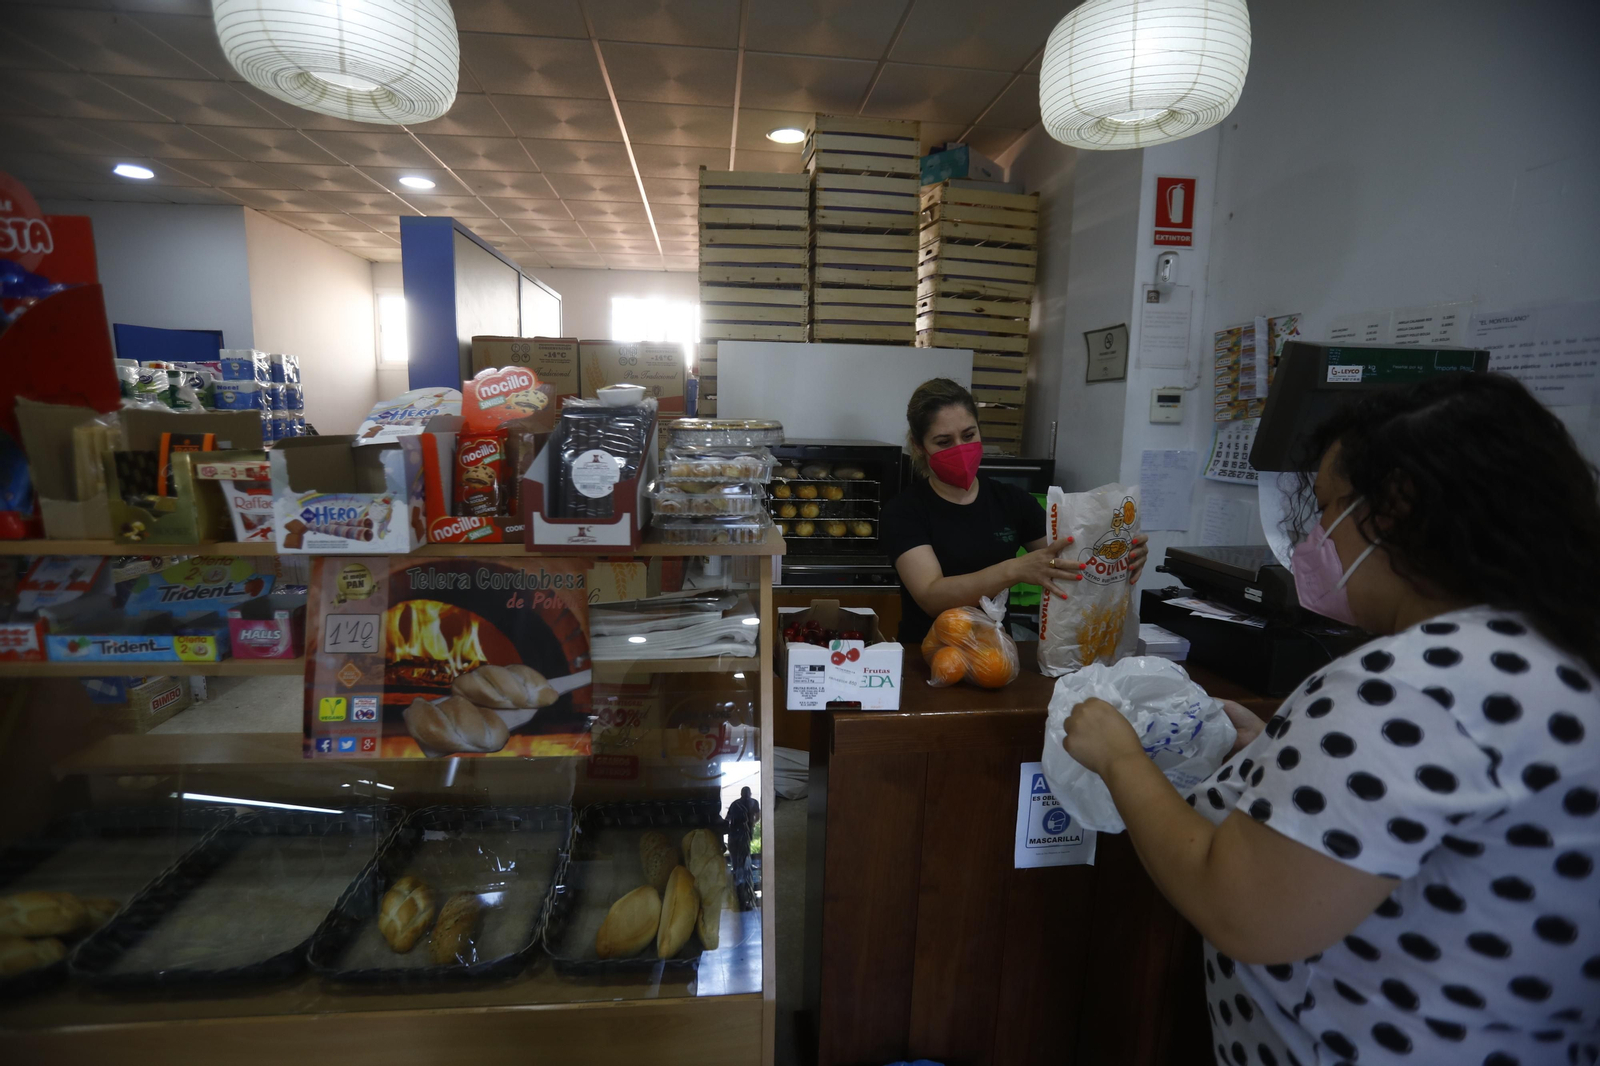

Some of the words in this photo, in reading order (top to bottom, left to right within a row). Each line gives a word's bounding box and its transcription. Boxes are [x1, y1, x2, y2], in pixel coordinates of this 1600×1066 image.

[1156, 234, 1191, 242] EXTINTOR
[480, 375, 530, 399] nocilla
[391, 408, 439, 422] HERO
[461, 443, 497, 464] nocilla
[315, 506, 358, 526] HERO
[432, 517, 481, 541] nocilla
[346, 580, 365, 589] PAN
[406, 567, 471, 591] Telera
[476, 566, 586, 591] Cordobesa
[158, 582, 246, 603] Trident
[506, 591, 525, 609] de
[240, 629, 281, 641] HALLS
[92, 638, 171, 655] Trident
[152, 688, 181, 710] BIMBO
[1029, 835, 1081, 845] MASCARILLA
